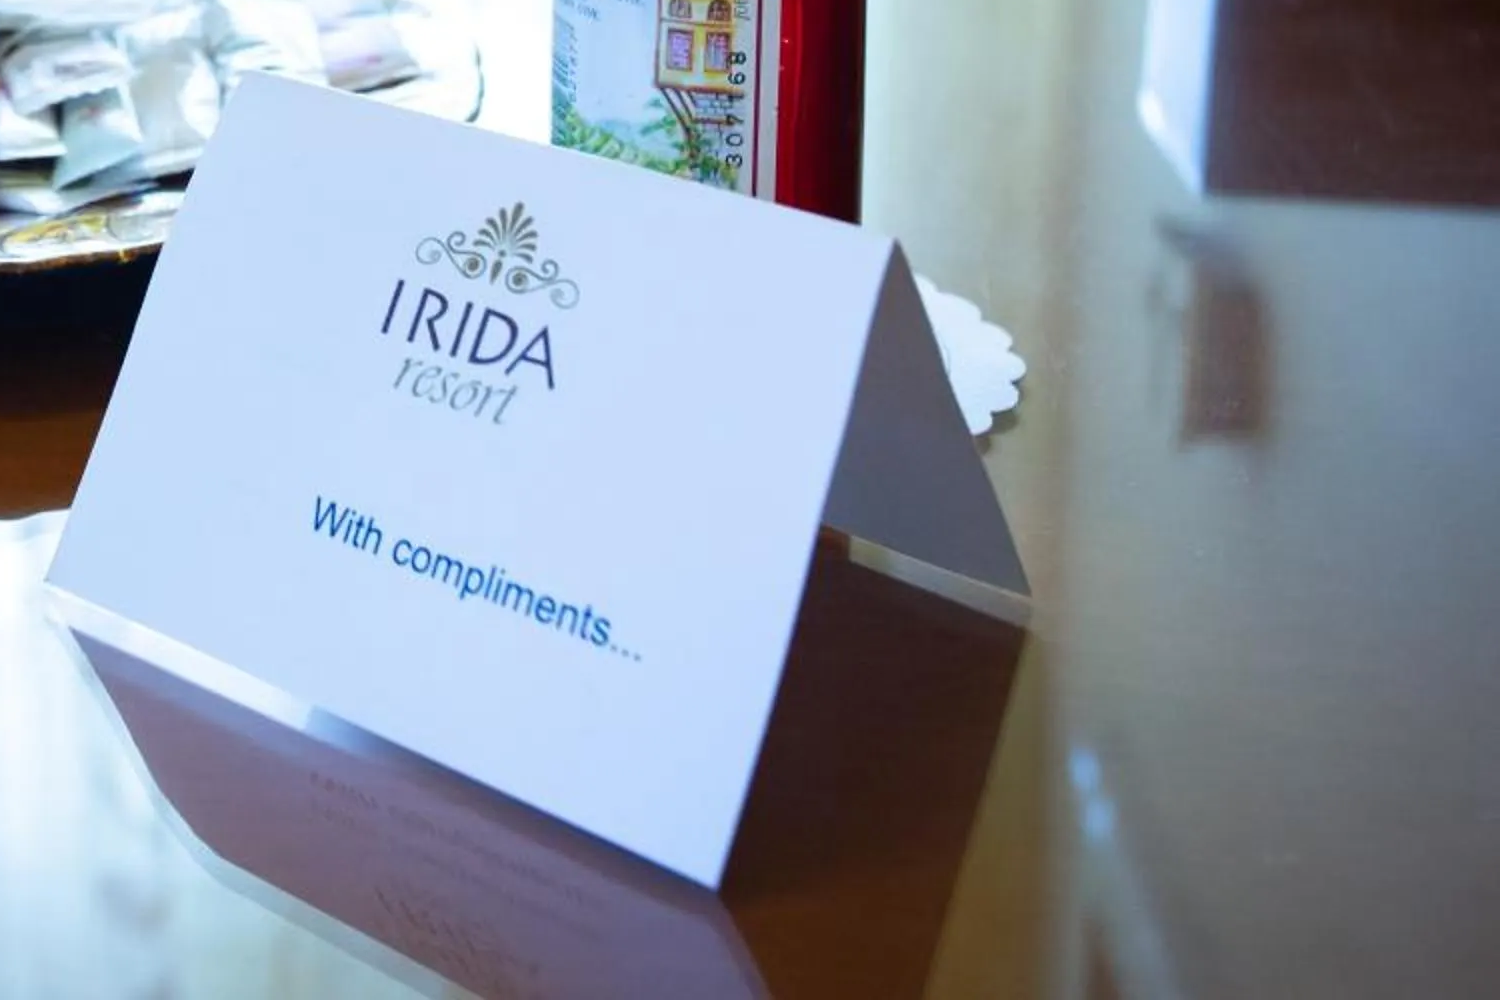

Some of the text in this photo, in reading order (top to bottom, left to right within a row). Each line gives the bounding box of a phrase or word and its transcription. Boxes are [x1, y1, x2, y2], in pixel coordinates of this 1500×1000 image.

[380, 279, 556, 390] IRIDA
[393, 356, 518, 425] resort
[312, 496, 642, 662] With compliments...
